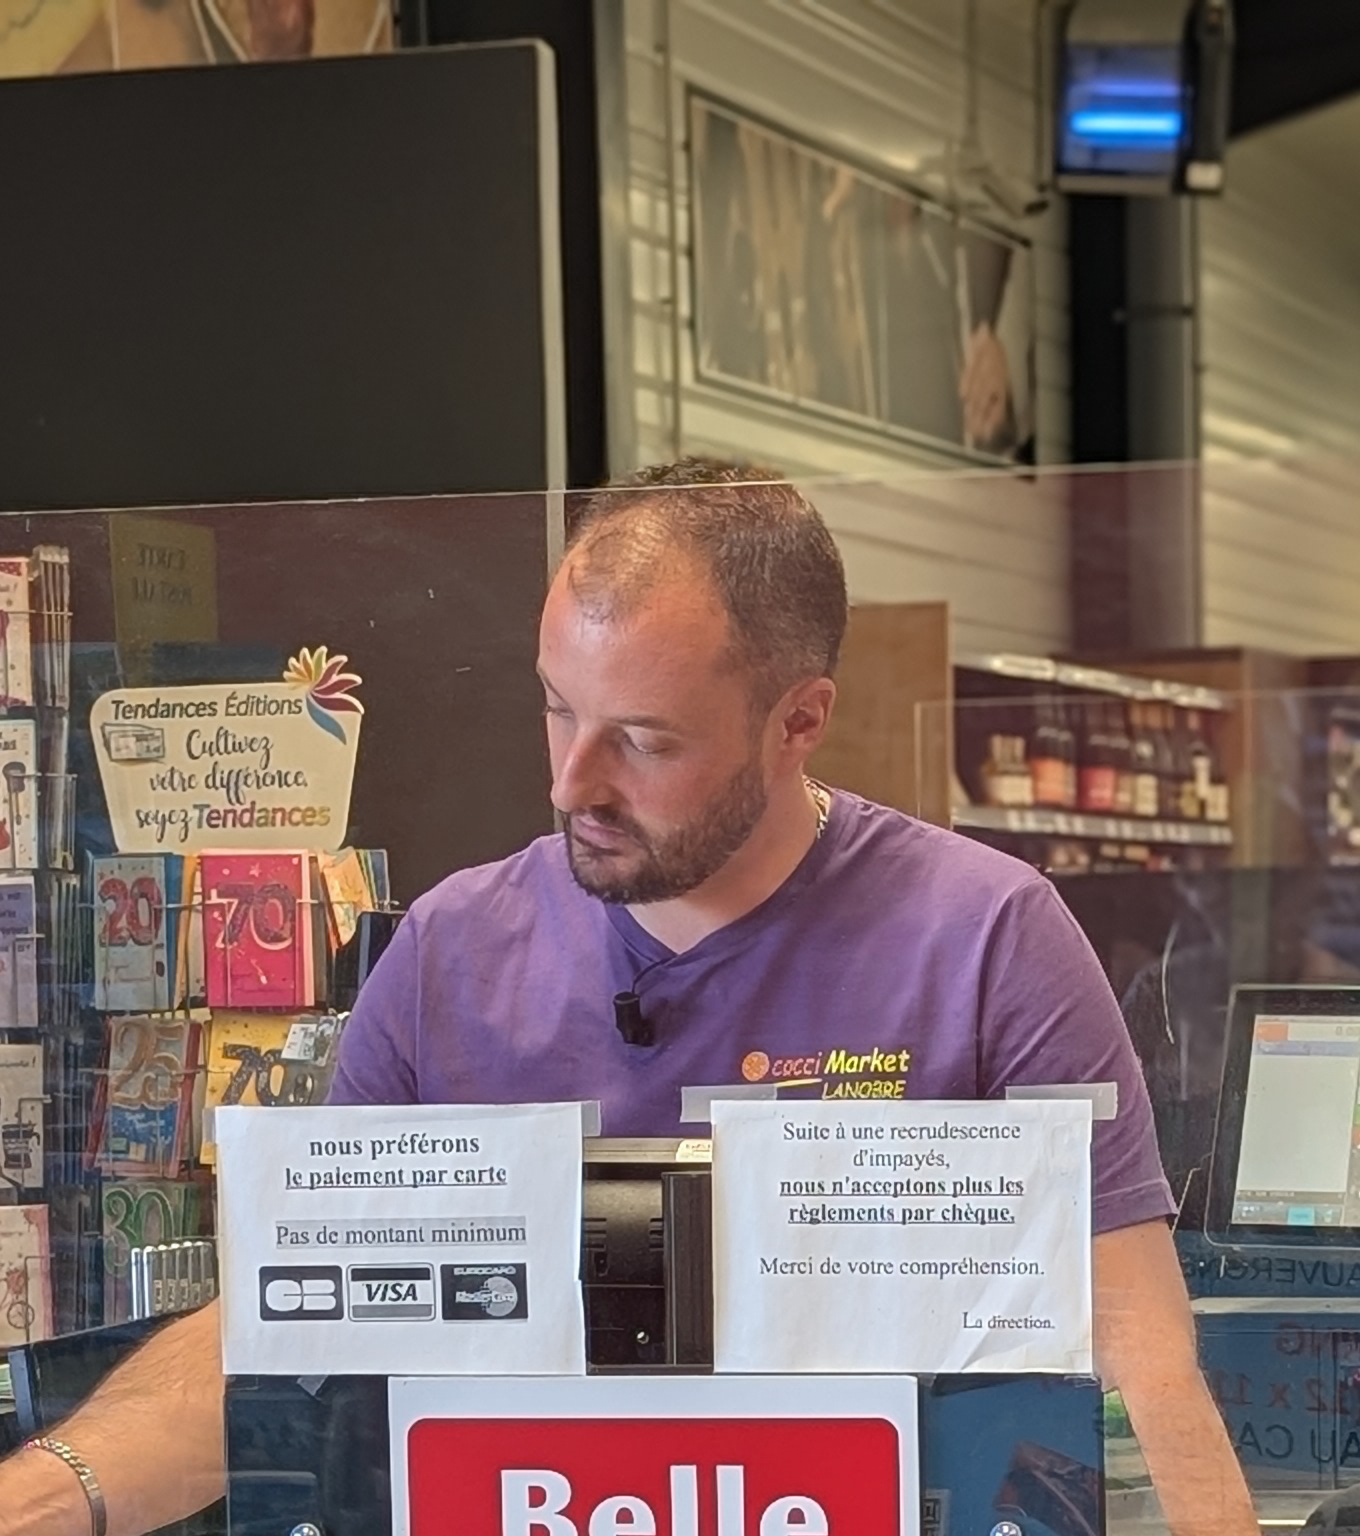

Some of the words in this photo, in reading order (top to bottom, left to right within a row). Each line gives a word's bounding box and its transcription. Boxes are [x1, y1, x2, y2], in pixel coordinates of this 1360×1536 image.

[112, 698, 218, 721] Tendances
[225, 691, 302, 717] Éditions
[186, 726, 274, 769] Cultivez
[149, 769, 197, 792] votre
[135, 808, 191, 843] soyez
[192, 801, 331, 829] Tendances
[98, 877, 163, 948] 20
[215, 882, 297, 951] 70
[110, 1019, 184, 1110] 25
[771, 1052, 823, 1077] cocci
[824, 1047, 911, 1075] Market
[821, 1080, 906, 1100] LANOBRE
[783, 1121, 831, 1141] Suite
[835, 1121, 846, 1140] à
[852, 1125, 885, 1140] une
[890, 1121, 1021, 1140] recrudescence
[309, 1139, 363, 1157] nous
[370, 1133, 481, 1160] préférons
[853, 1149, 951, 1172] d'impayés,
[285, 1167, 303, 1188] le
[309, 1167, 404, 1190] paiement
[412, 1170, 448, 1189] par
[454, 1164, 508, 1184] carte
[779, 1179, 826, 1196] nous
[832, 1176, 946, 1199] n'acceptons
[952, 1177, 993, 1199] plus
[999, 1176, 1025, 1195] les
[788, 1203, 895, 1224] règlements
[901, 1206, 936, 1224] par
[276, 1226, 310, 1245] Pas
[316, 1224, 339, 1245] de
[345, 1225, 426, 1245] montant
[431, 1222, 527, 1243] minimum
[760, 1256, 814, 1276] Merci
[820, 1258, 841, 1275] de
[847, 1260, 894, 1275] votre
[899, 1257, 1045, 1280] compréhension.
[364, 1282, 419, 1302] VISA
[963, 1311, 983, 1330] La
[987, 1313, 1056, 1330] direction.
